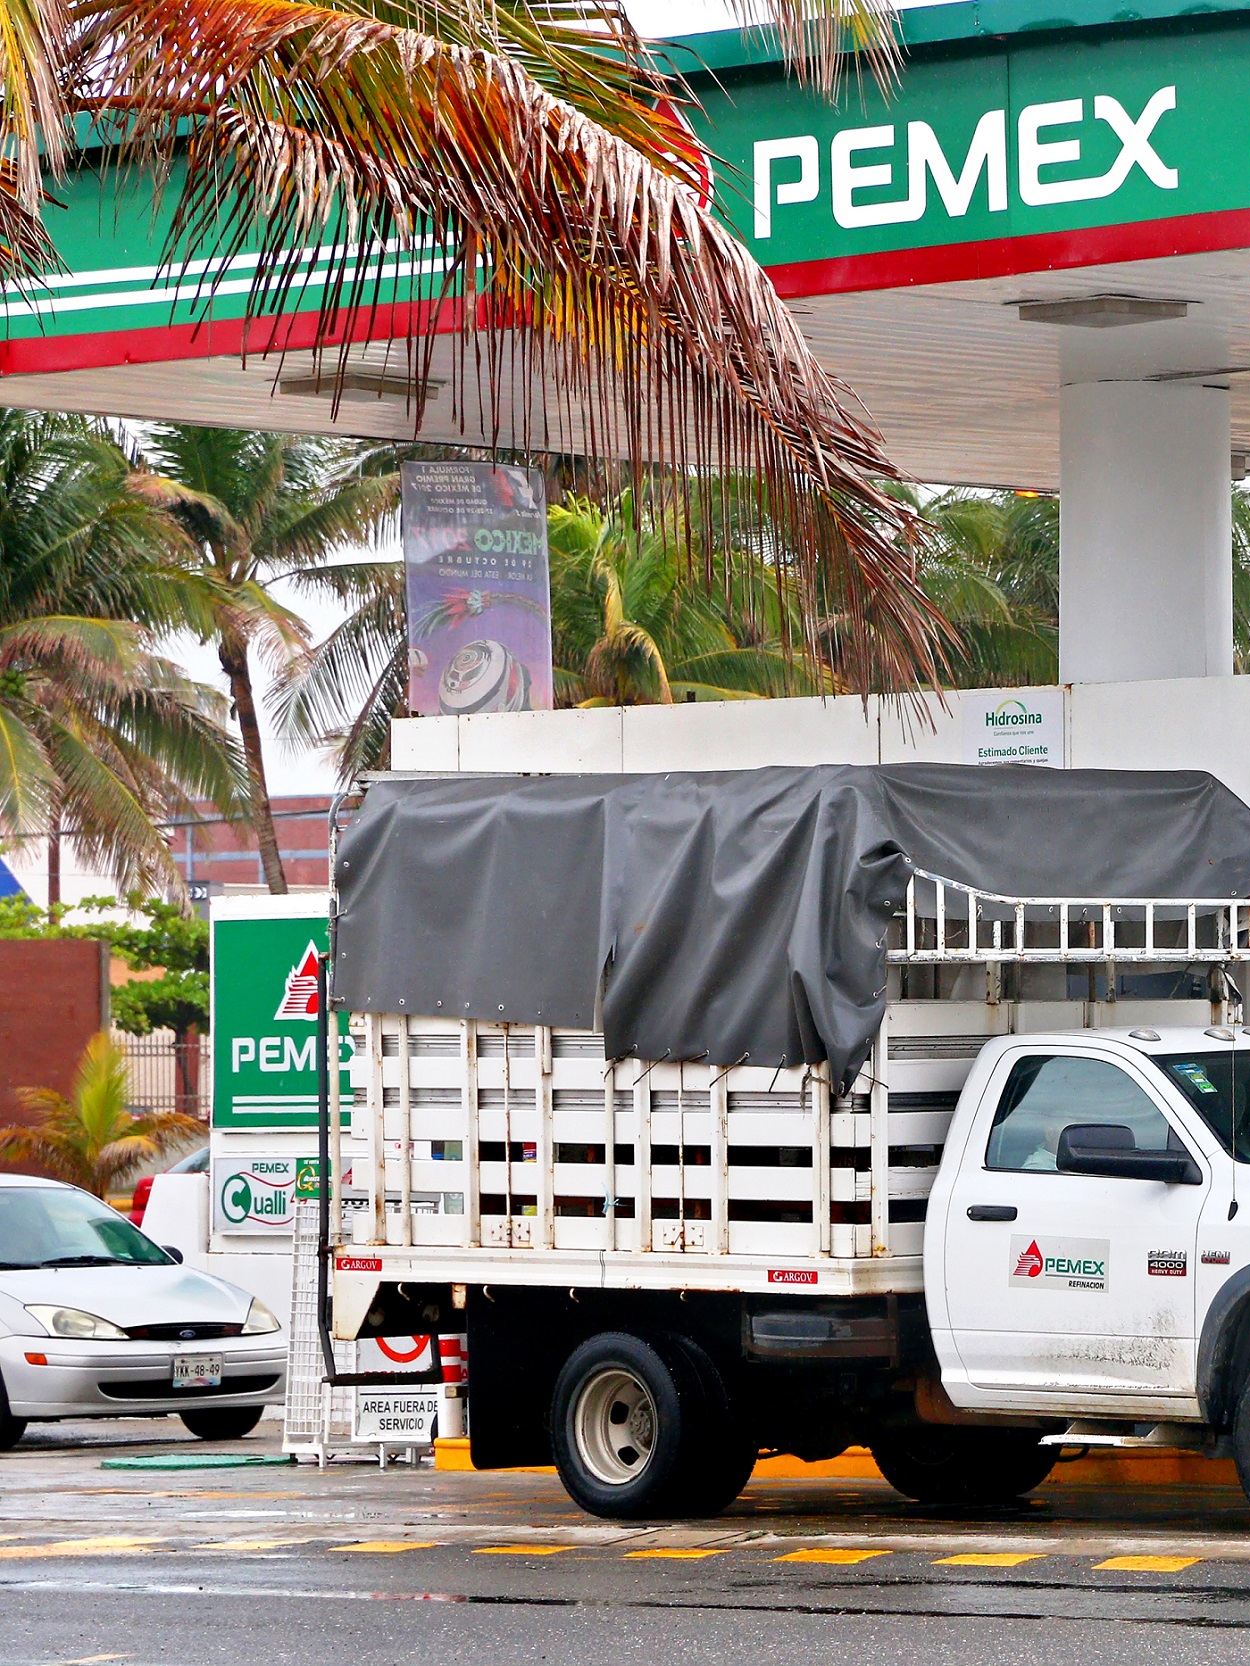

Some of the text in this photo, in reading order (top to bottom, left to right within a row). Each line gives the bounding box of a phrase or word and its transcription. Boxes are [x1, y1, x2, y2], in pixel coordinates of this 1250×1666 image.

[754, 86, 1178, 239] PEMEX
[986, 711, 1042, 726] Hidrosina
[978, 745, 1048, 757] Estimado Cliente
[252, 1163, 289, 1173] PEMEX
[1045, 1258, 1105, 1276] PEMEX
[1150, 1261, 1184, 1269] 4000
[1068, 1280, 1105, 1290] REFINACION
[363, 1401, 391, 1413] AREA
[393, 1400, 423, 1413] FUERA
[379, 1418, 424, 1430] SERVICIO
